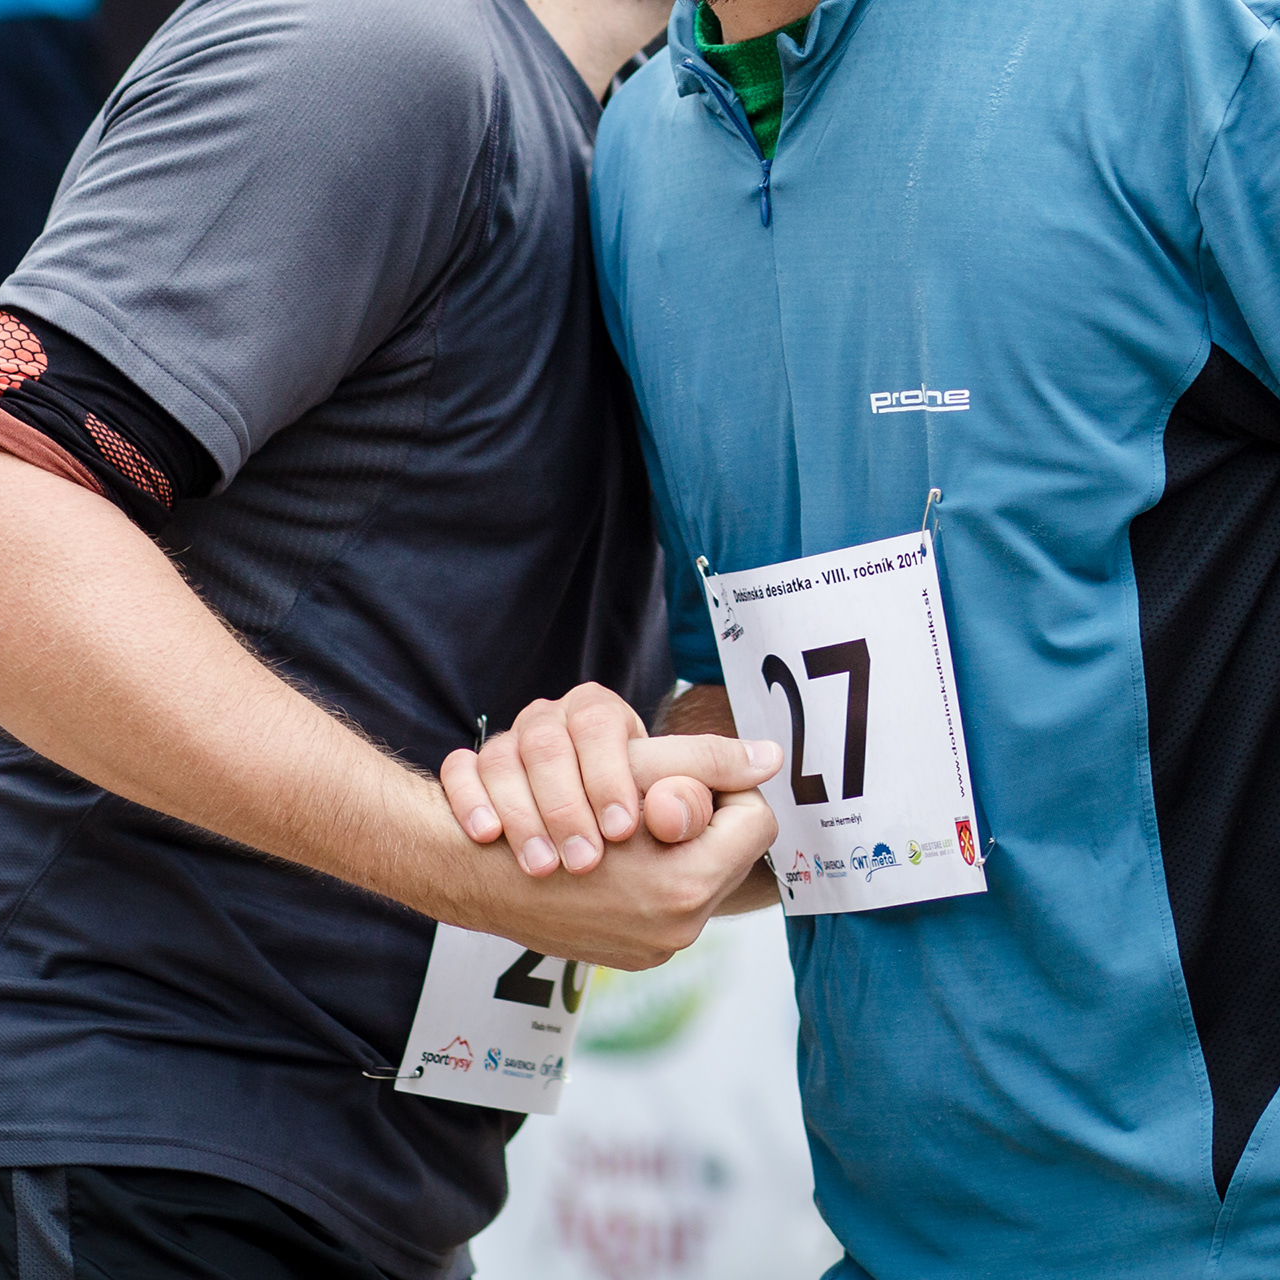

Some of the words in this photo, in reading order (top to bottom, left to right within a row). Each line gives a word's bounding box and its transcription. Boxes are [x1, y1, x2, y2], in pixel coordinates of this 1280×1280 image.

[765, 577, 812, 599] desiatka
[821, 567, 851, 586] VIII.
[853, 556, 895, 580] ročník
[896, 549, 926, 570] 2017
[761, 638, 871, 806] 27
[851, 854, 870, 871] CWT
[871, 850, 897, 867] metal
[421, 1050, 473, 1072] sportrysy
